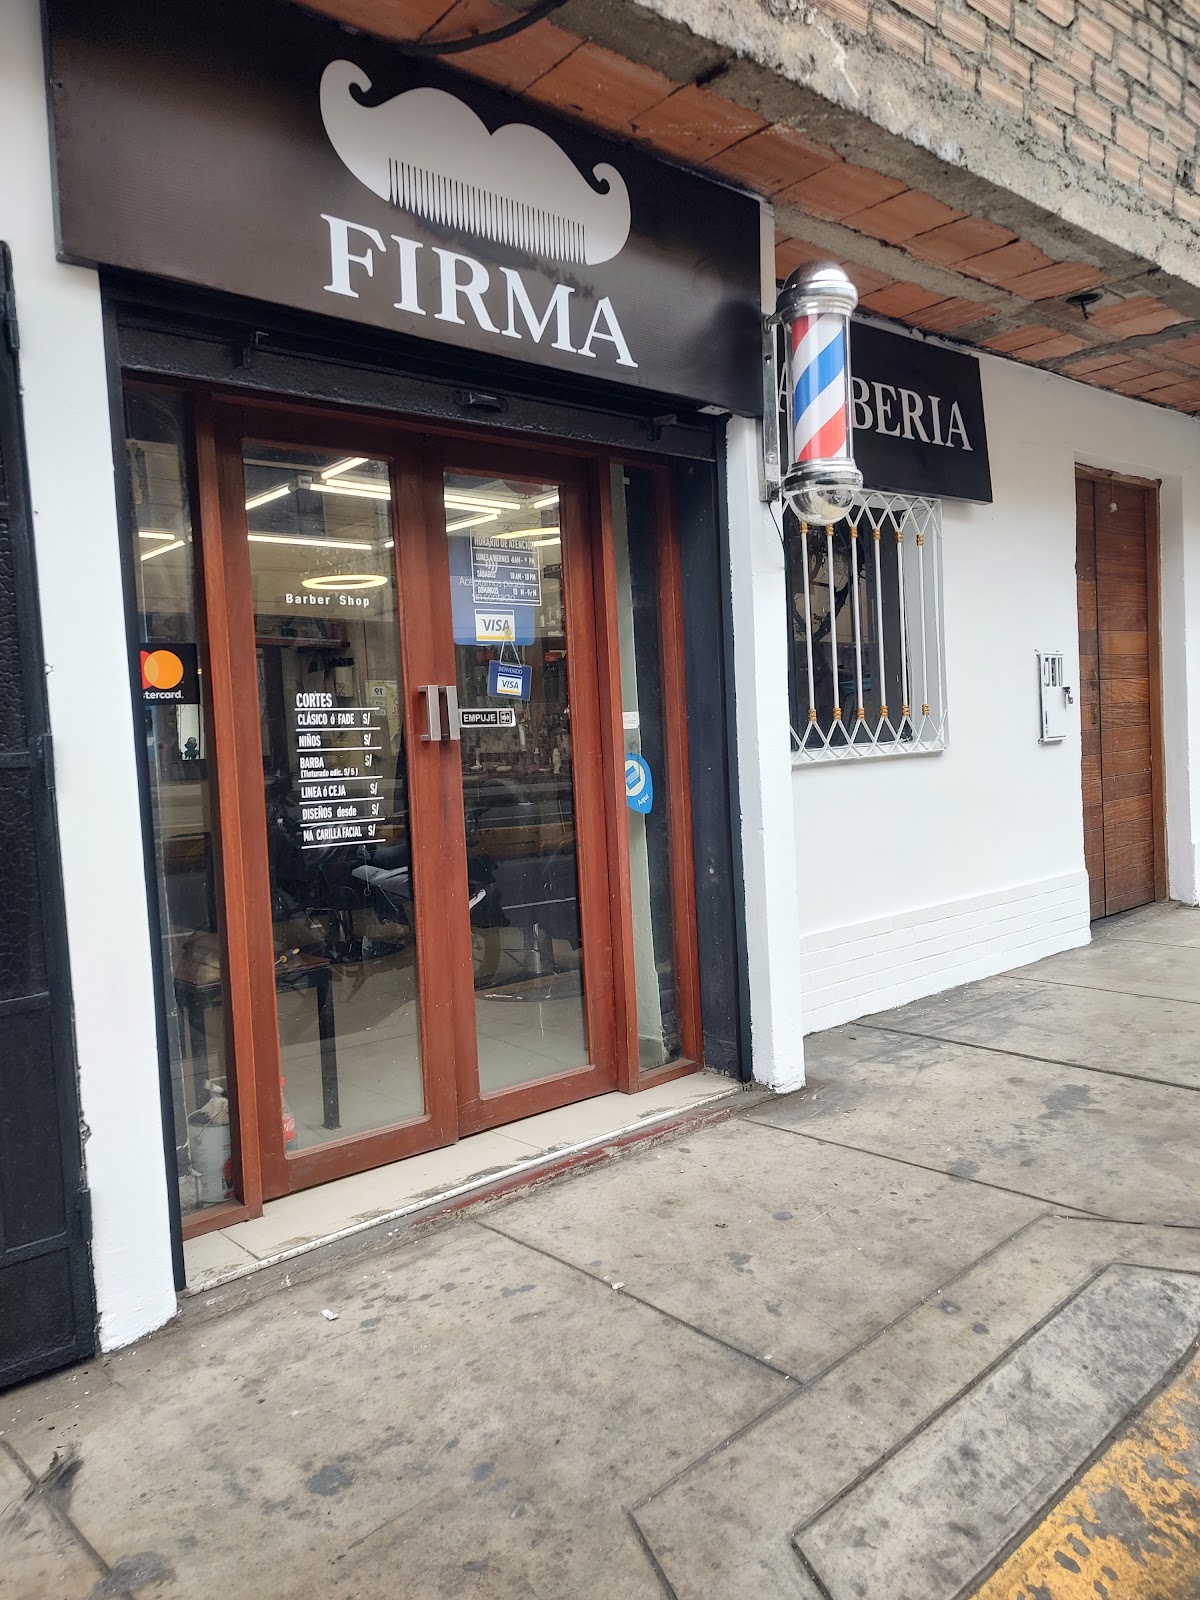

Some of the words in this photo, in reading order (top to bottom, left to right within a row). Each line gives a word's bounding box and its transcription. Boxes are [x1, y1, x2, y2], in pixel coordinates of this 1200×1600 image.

[319, 213, 639, 368] FIRMA
[474, 536, 500, 548] HORARIO
[500, 539, 508, 548] DE
[475, 553, 490, 562] LUNES
[492, 555, 510, 563] VIERNES
[459, 576, 502, 588] Aceptamos
[478, 586, 499, 595] DOMINGOS
[285, 593, 331, 605] Barber
[339, 595, 370, 609] Shop
[480, 618, 510, 632] VISA
[498, 666, 523, 675] BIENVENIDO
[501, 679, 519, 689] VISA
[295, 692, 333, 708] CORTES
[297, 711, 328, 726] CLÁSICO
[337, 713, 355, 725] FADE
[362, 712, 371, 726] S/
[463, 713, 496, 723] EMPUJE
[298, 732, 322, 748] NIÑOS
[363, 733, 372, 747] S/
[299, 757, 325, 769] BARBA
[364, 753, 373, 768] S/
[300, 768, 329, 778] (Tinturado
[301, 786, 322, 799] LINEA
[328, 784, 347, 797] CEJA
[369, 782, 379, 795] S/
[302, 805, 333, 821] DISEÑOS
[336, 805, 357, 818] desde
[371, 802, 380, 816] S/
[342, 825, 363, 839] FACIAL
[367, 823, 376, 837] S/
